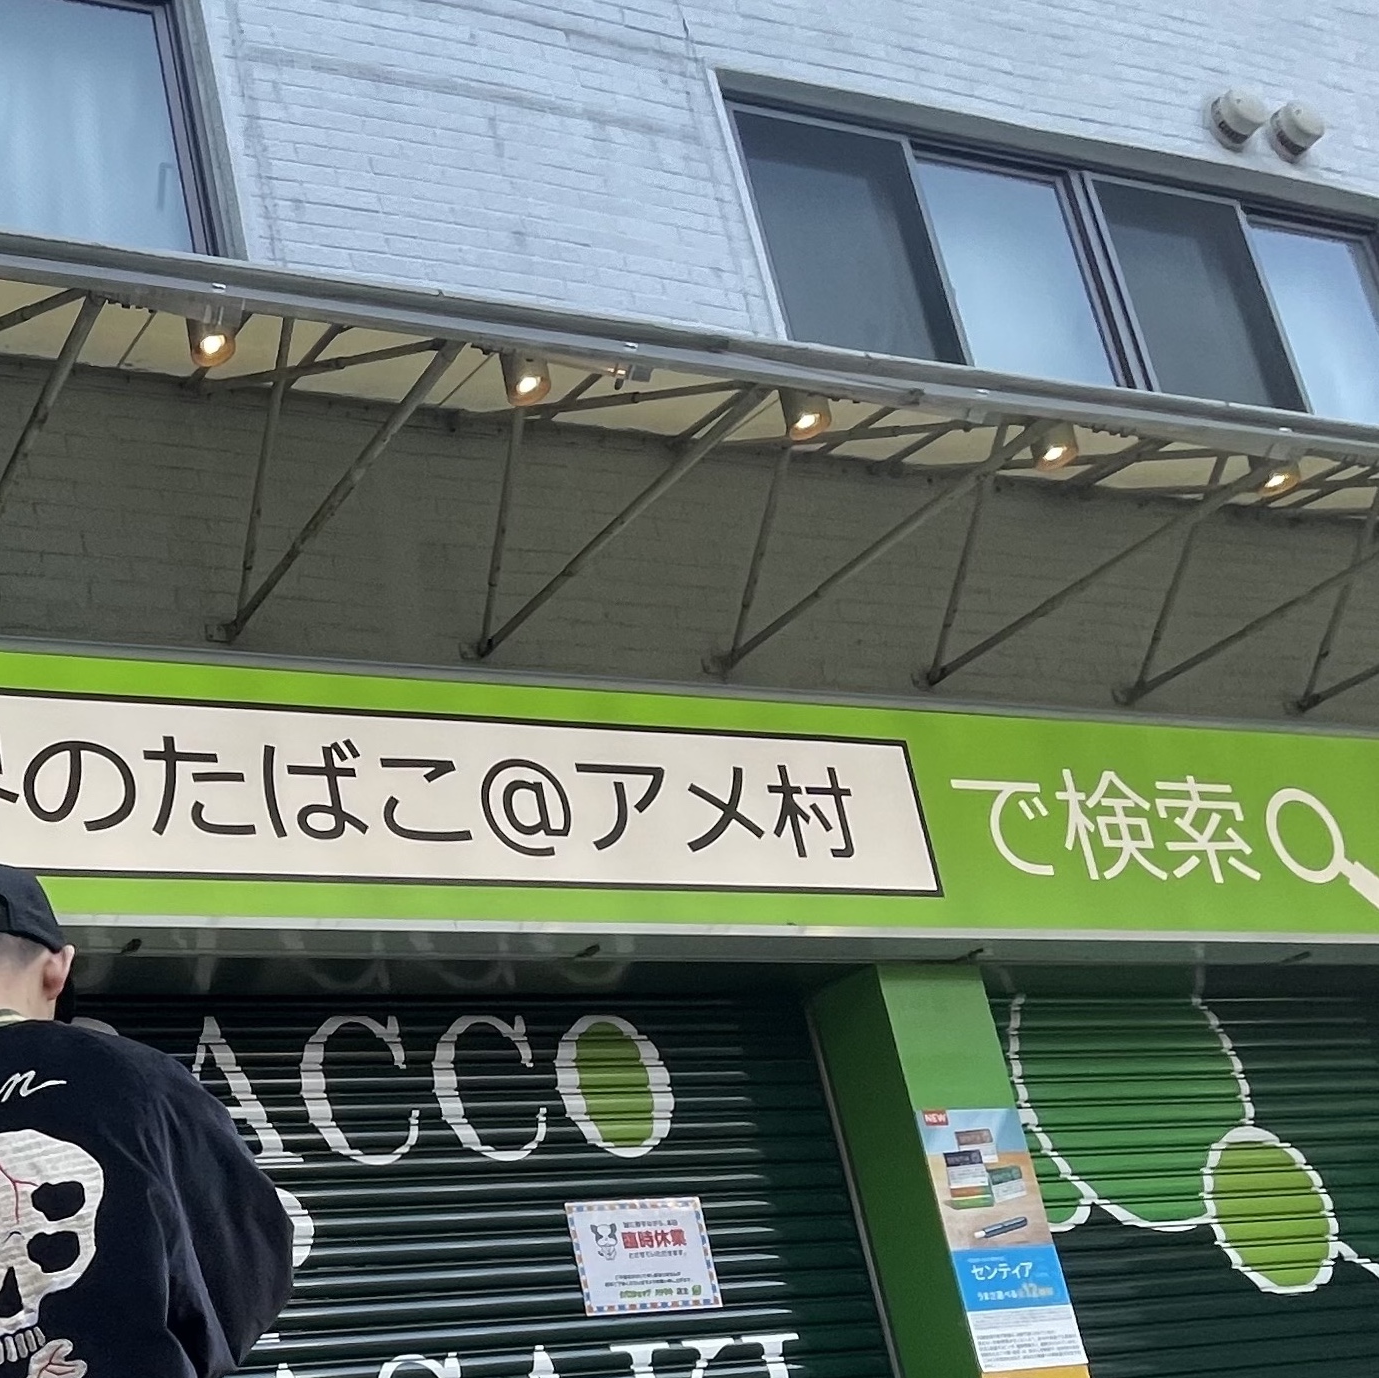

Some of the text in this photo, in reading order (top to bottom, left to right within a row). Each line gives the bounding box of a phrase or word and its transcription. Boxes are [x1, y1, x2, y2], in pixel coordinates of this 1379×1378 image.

[950, 769, 1261, 883] で検索
[924, 1113, 946, 1123] NEW
[621, 1229, 687, 1249] 臨時休業
[971, 1262, 1033, 1281] センティア
